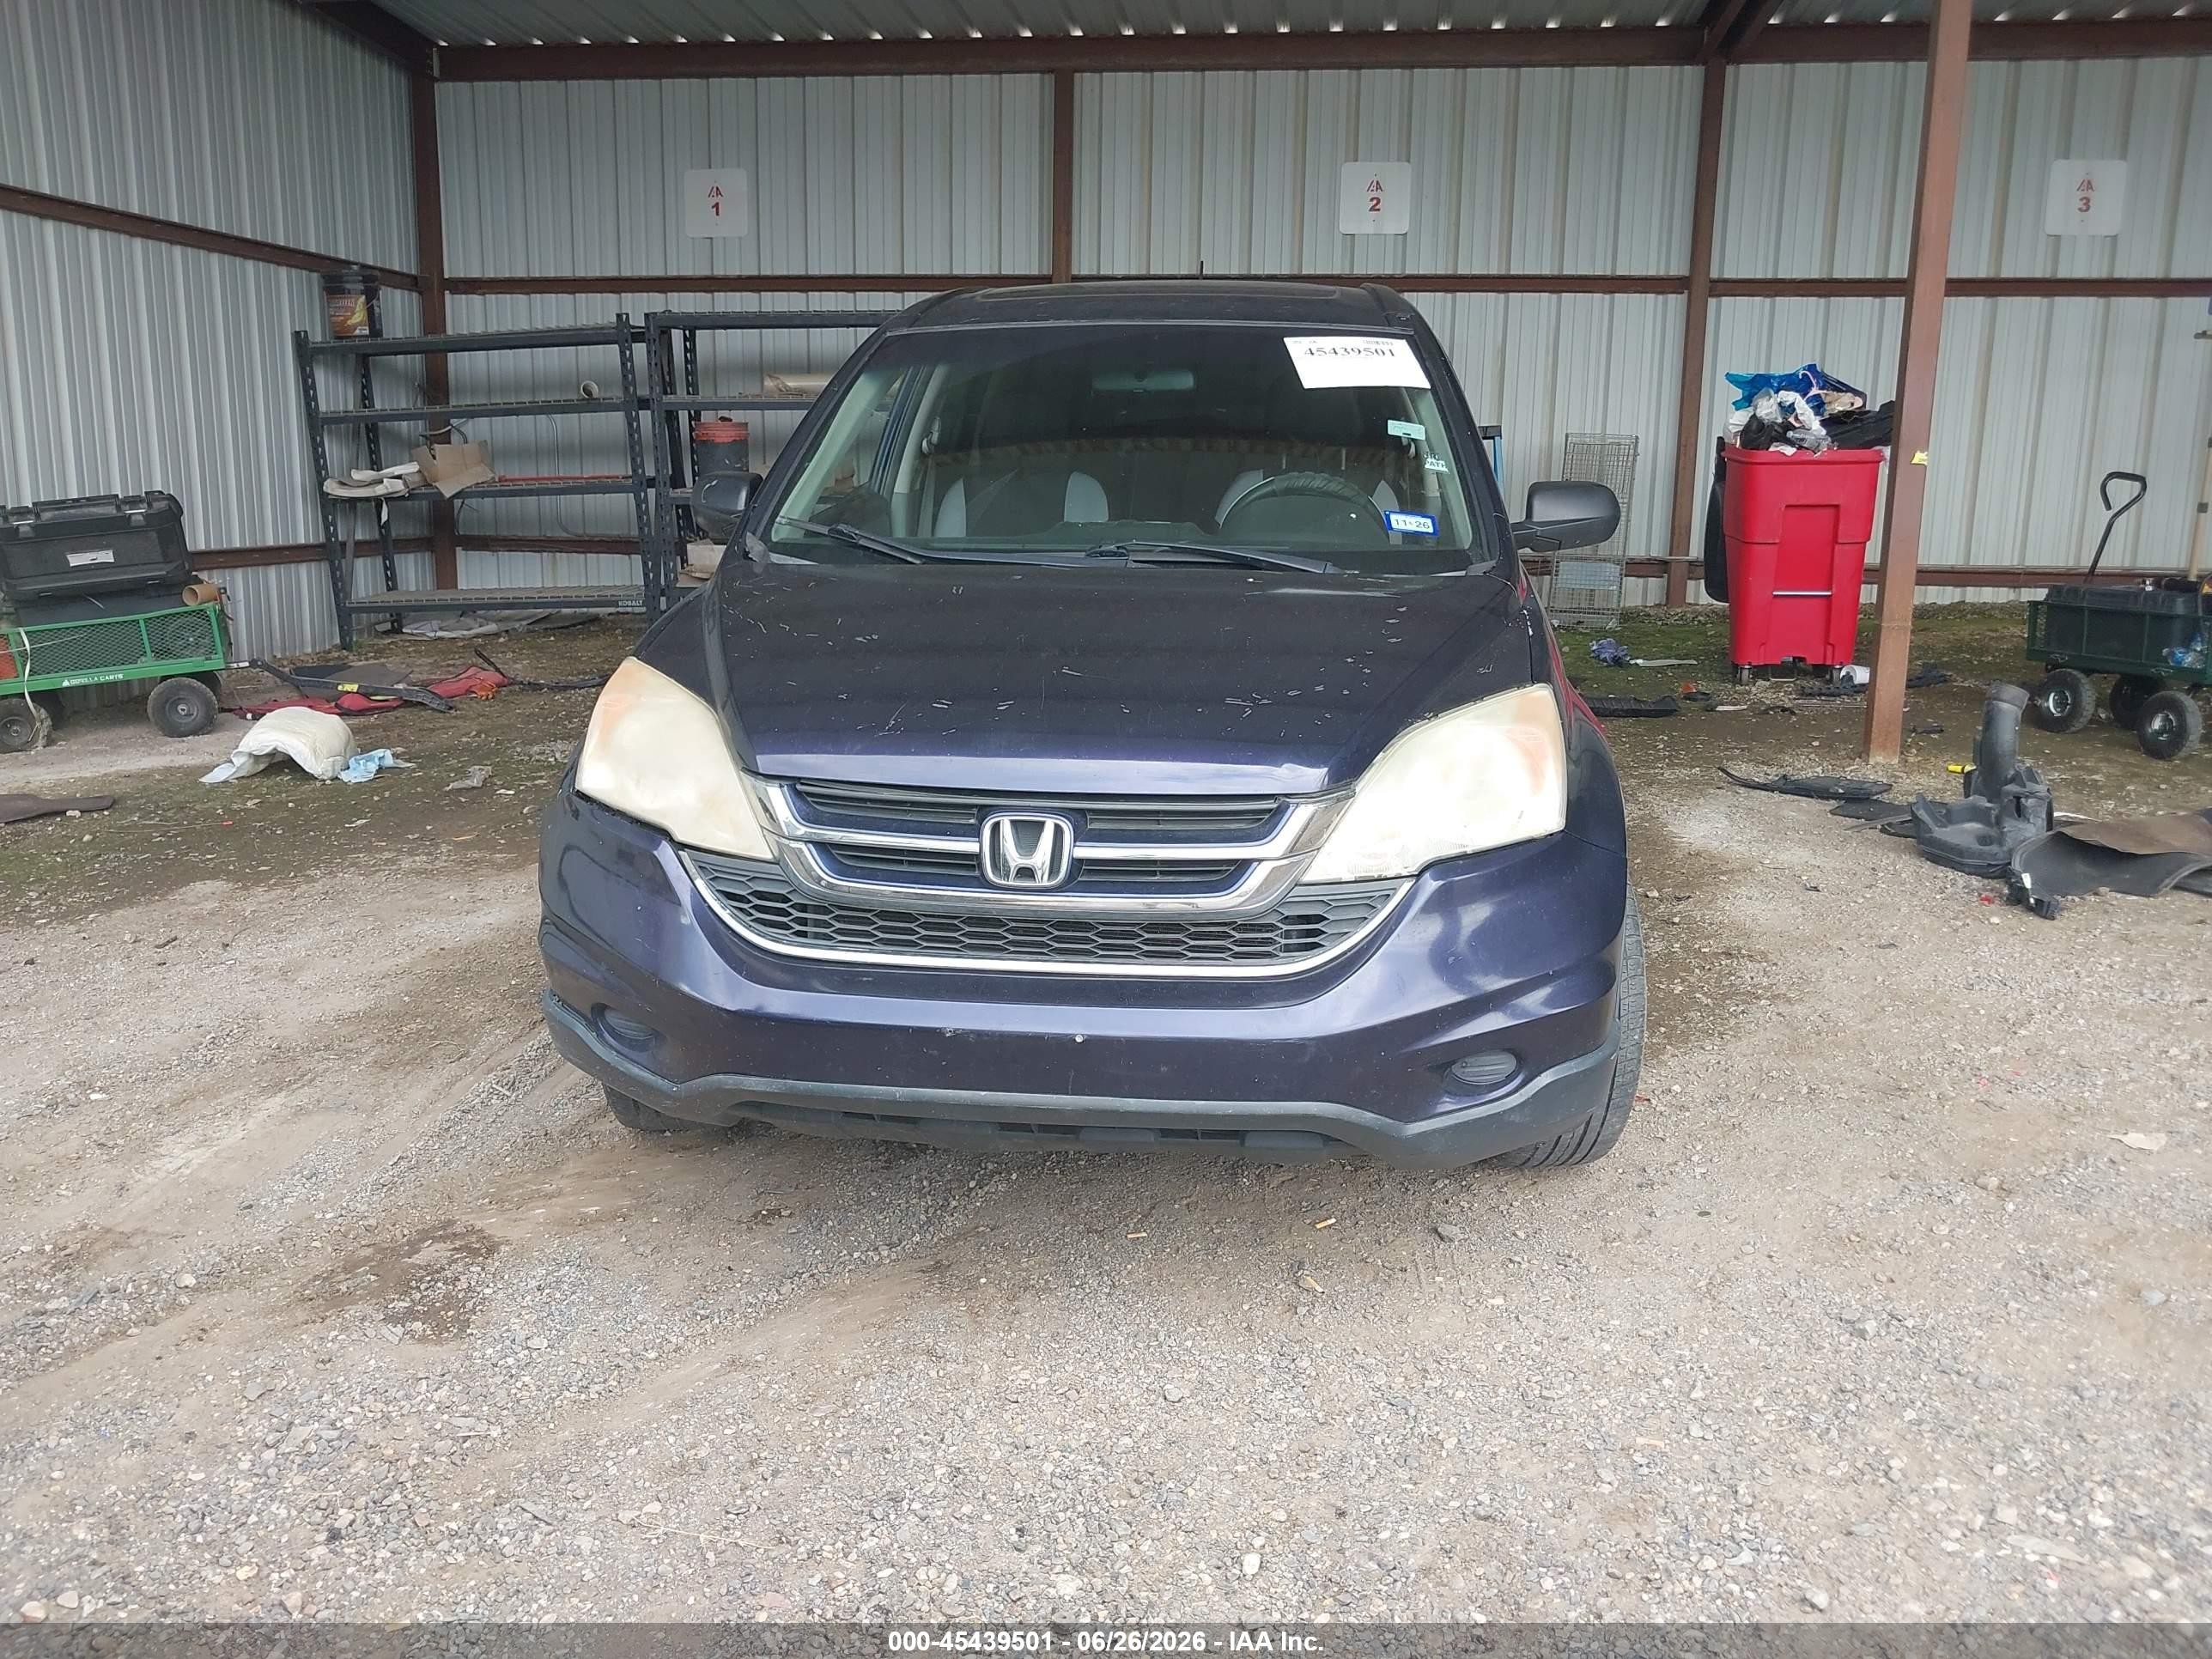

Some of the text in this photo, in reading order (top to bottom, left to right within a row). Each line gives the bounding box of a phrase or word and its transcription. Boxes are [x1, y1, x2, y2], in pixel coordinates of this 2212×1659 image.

[711, 202, 720, 216] 1
[1368, 197, 1381, 212] 2
[2077, 196, 2091, 213] 3
[1304, 347, 1395, 357] 45439501
